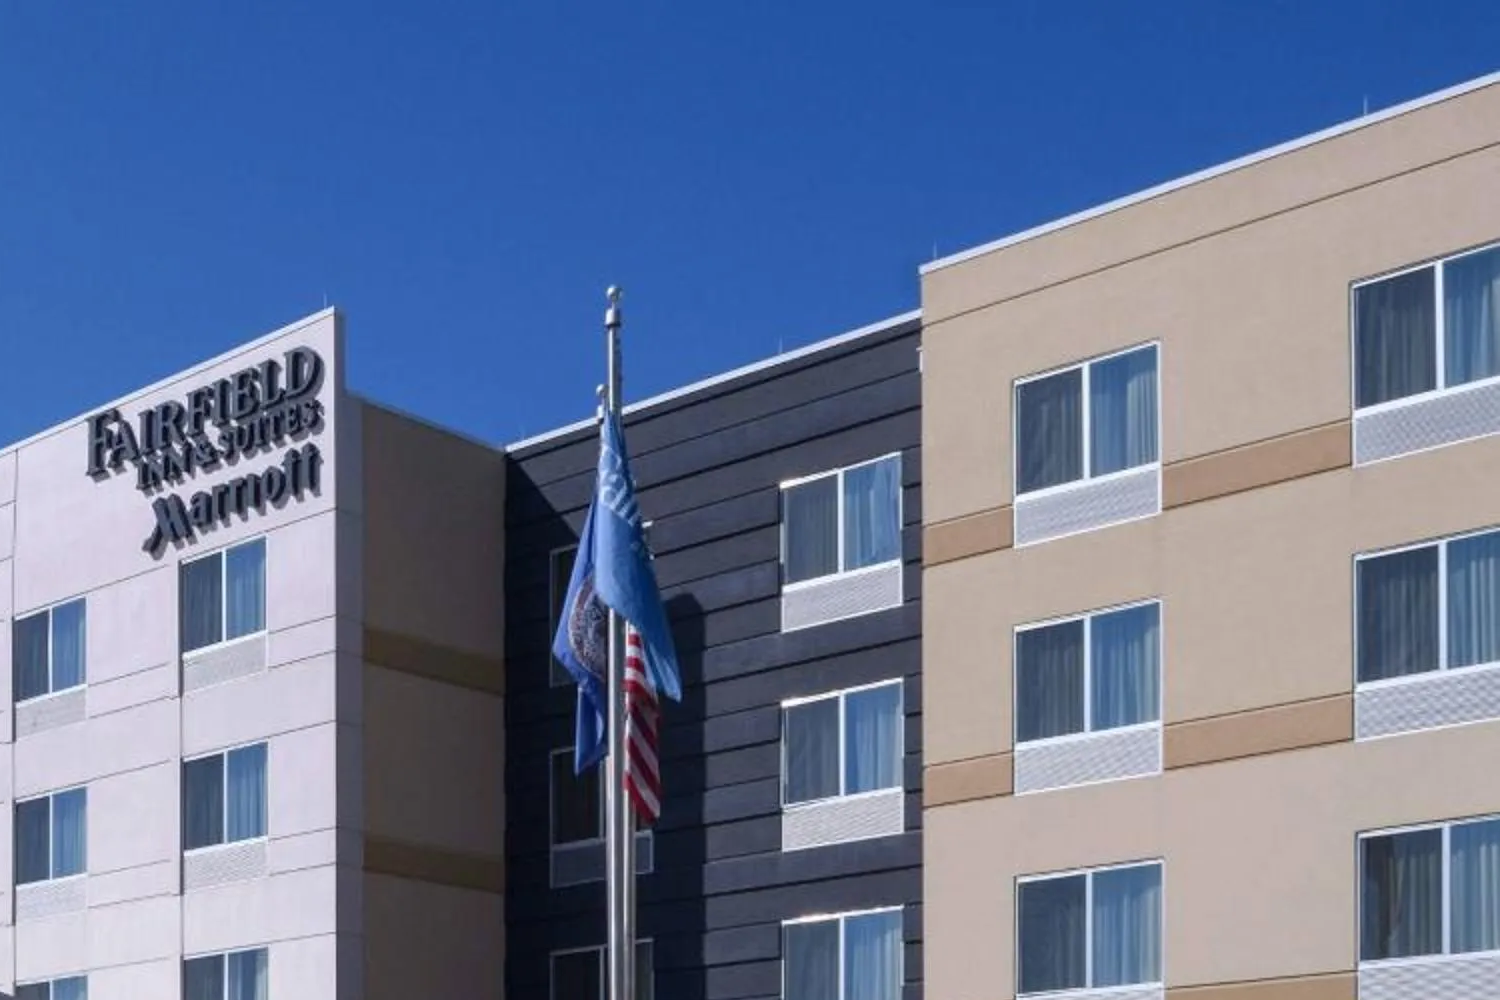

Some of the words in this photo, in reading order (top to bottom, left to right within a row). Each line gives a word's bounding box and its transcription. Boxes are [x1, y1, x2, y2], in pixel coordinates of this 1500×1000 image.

[86, 345, 325, 479] FAIRFIELD
[136, 440, 195, 495] INN
[218, 398, 325, 466] SUITES
[142, 442, 324, 559] Marriott
